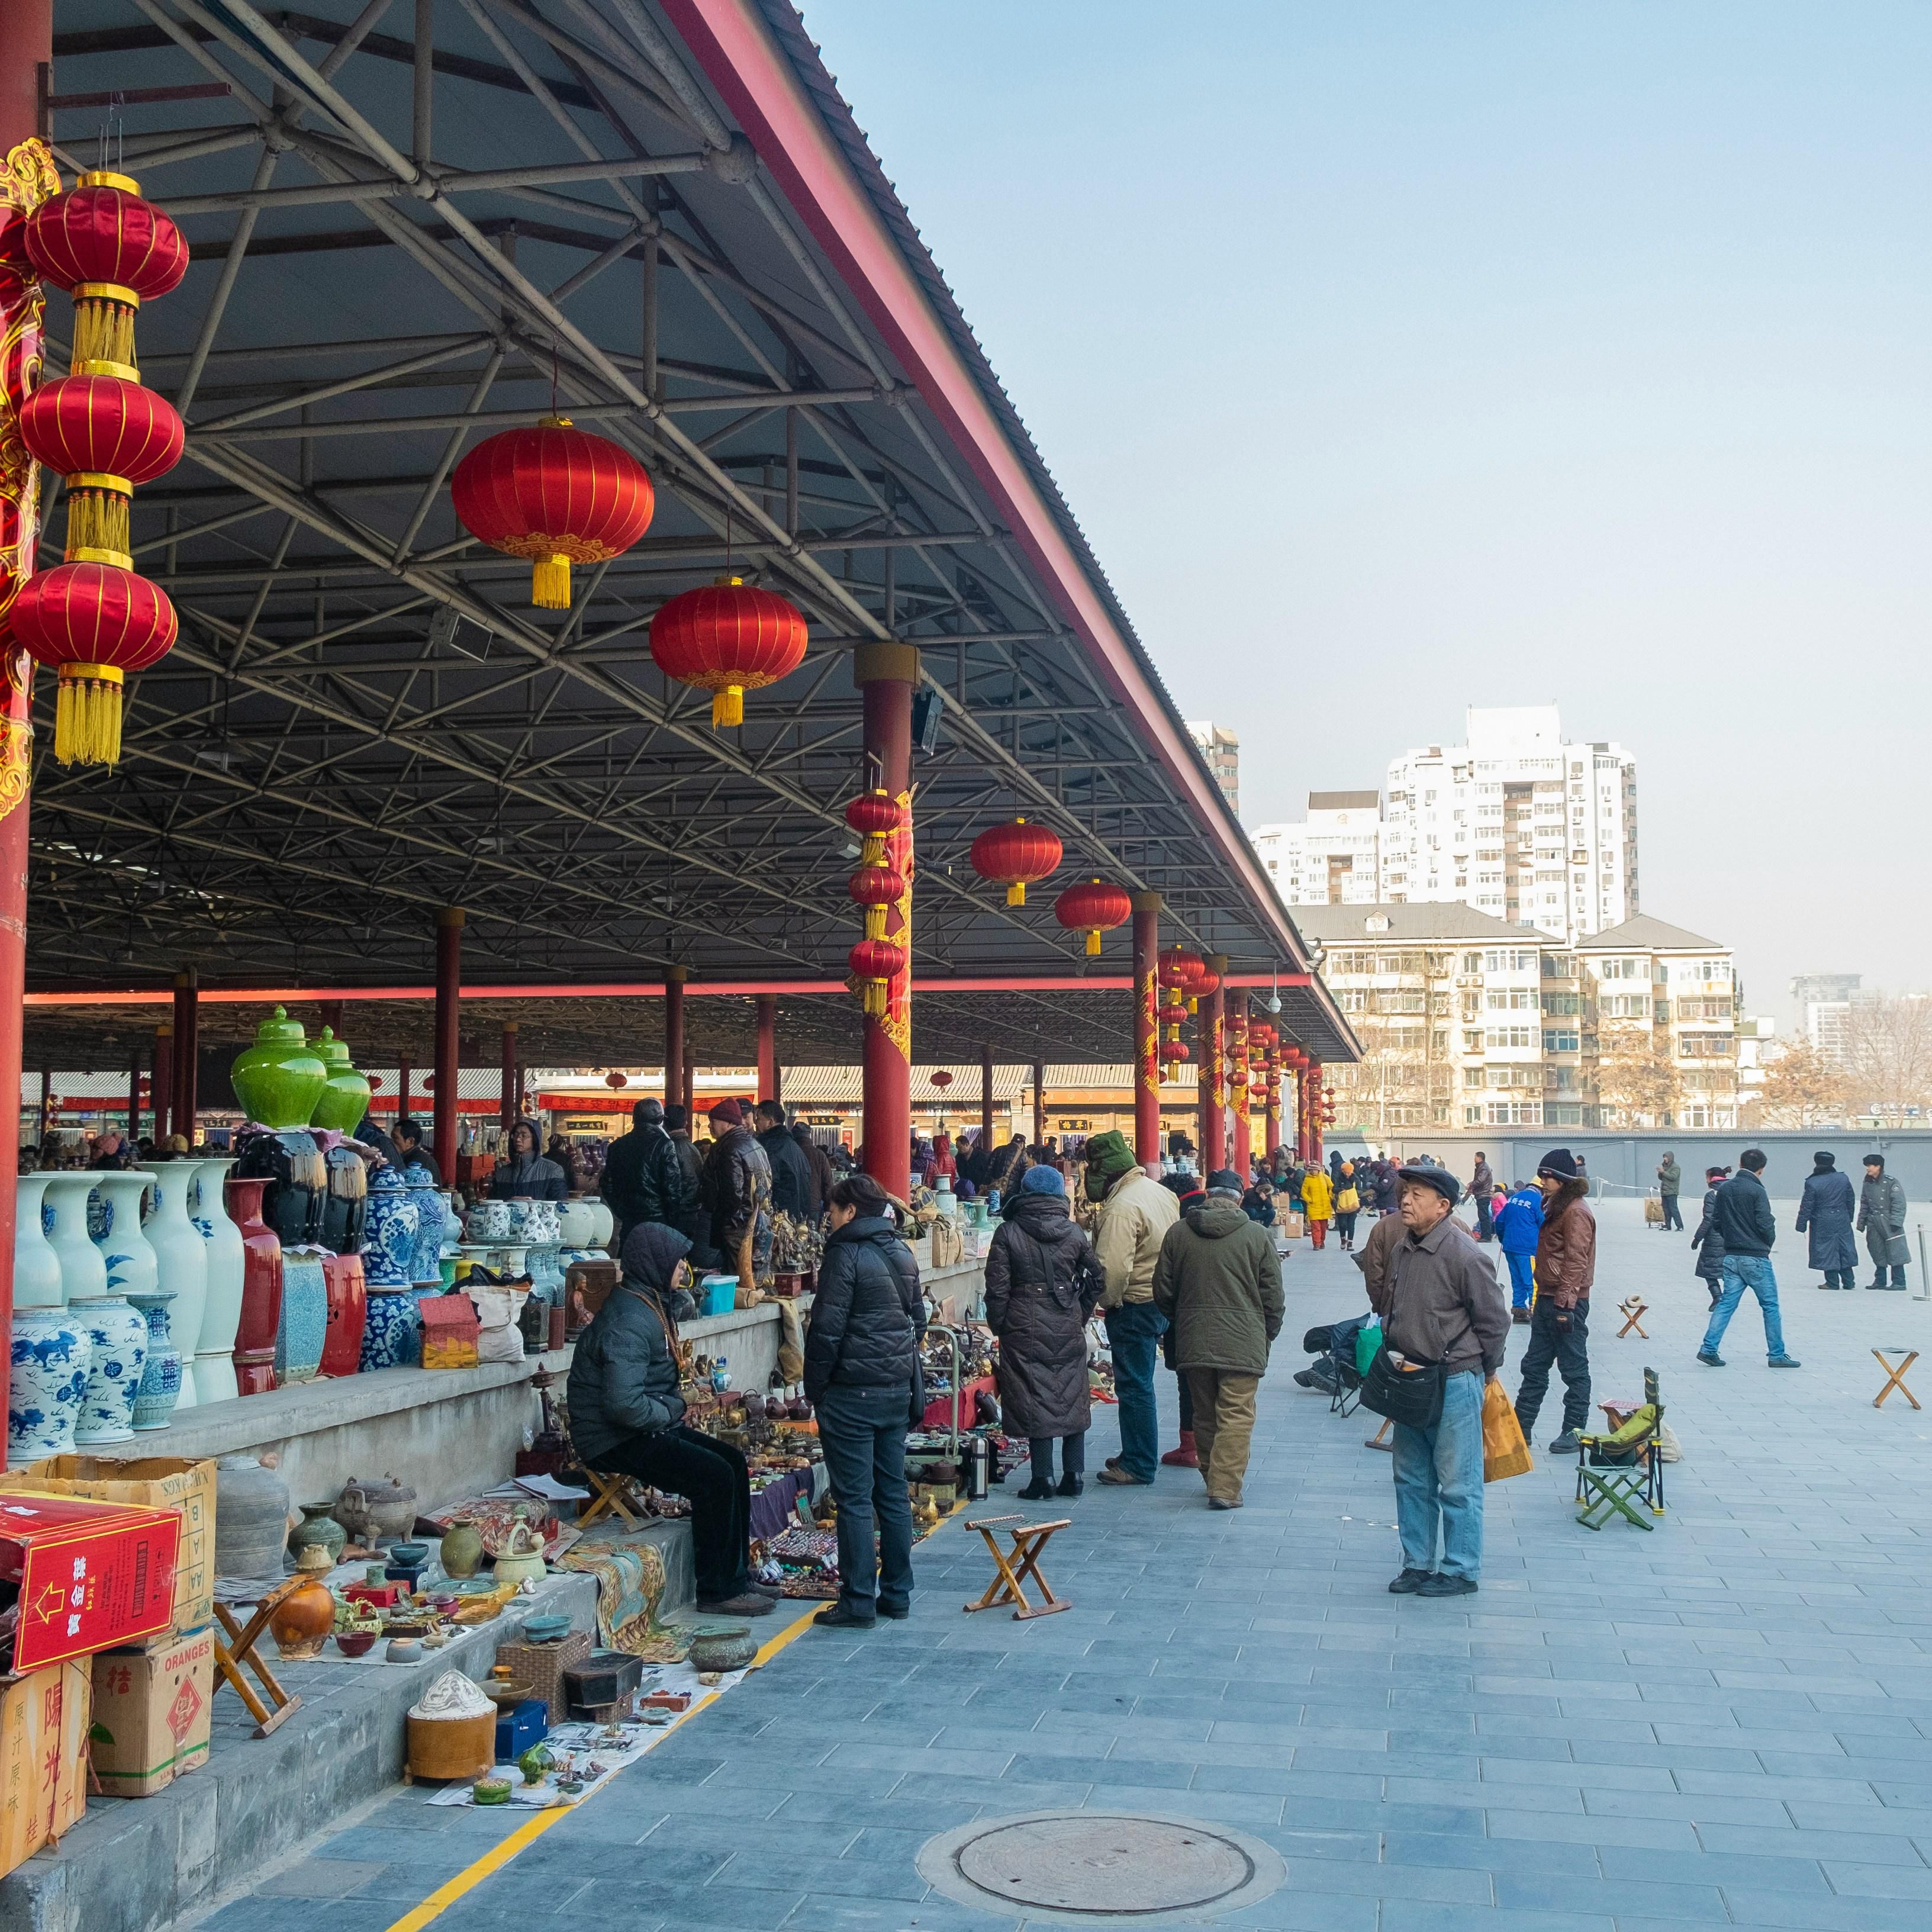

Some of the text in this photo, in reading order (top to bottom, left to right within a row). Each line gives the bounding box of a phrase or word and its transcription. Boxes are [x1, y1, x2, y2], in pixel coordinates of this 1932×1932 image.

[192, 1505, 199, 1521] B
[194, 1538, 200, 1555] A
[190, 1569, 202, 1590] AA
[165, 1640, 210, 1672] ORANGES
[43, 1680, 62, 1793] 陽光
[8, 1701, 25, 1815] 原汁原味
